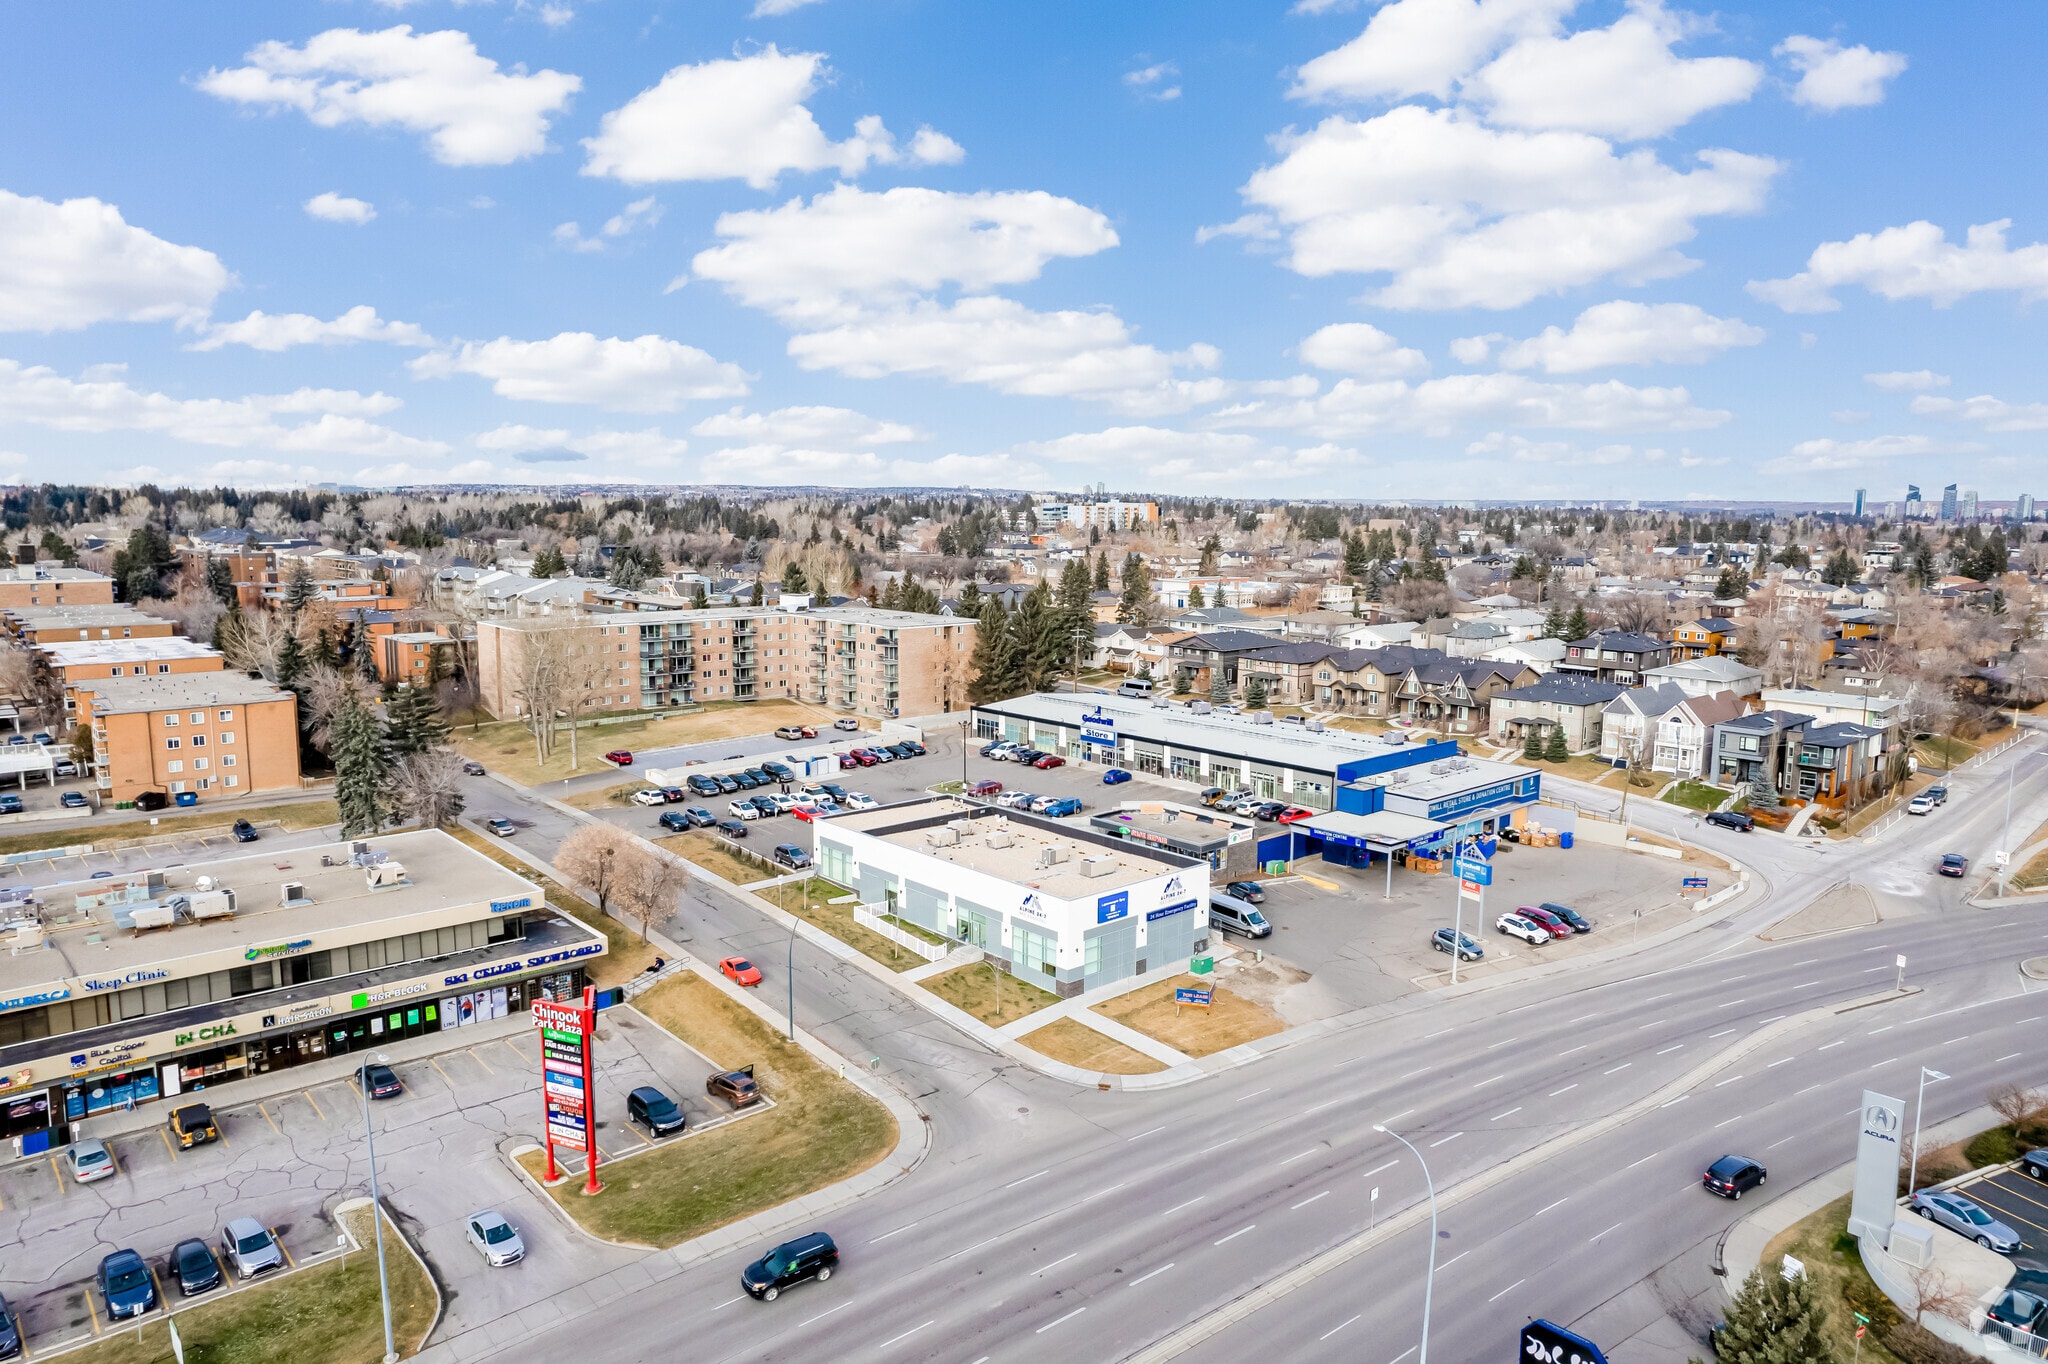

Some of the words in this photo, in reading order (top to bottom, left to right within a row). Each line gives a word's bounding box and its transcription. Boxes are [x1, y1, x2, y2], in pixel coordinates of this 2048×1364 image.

[1082, 714, 1114, 726] Goodwill
[1086, 729, 1109, 739] Store
[1443, 799, 1458, 810] RETAIL
[1458, 794, 1472, 805] STORE
[1475, 787, 1496, 800] DONATION
[1495, 783, 1512, 794] CENTRE
[1313, 828, 1332, 836] DONATION
[1332, 833, 1348, 841] CENTRE
[1456, 859, 1481, 871] Godwill
[1160, 892, 1175, 901] ALPINE
[490, 898, 531, 912] RENOIR
[1019, 906, 1035, 915] ALPINE
[1164, 906, 1184, 915] Emergency
[267, 948, 303, 958] Services
[444, 973, 468, 986] SKI
[473, 961, 523, 979] CELLAR
[527, 944, 603, 968] SNOWBOARD
[85, 977, 122, 991] Sleep
[125, 968, 169, 983] Clinic
[370, 992, 392, 1002] H&R
[394, 983, 427, 997] BLOCK
[278, 1013, 301, 1025] HAIR
[302, 1006, 333, 1020] SALON
[532, 1003, 581, 1025] Chinook
[532, 1016, 555, 1030] Park
[556, 1021, 583, 1035] Plaza
[175, 1031, 194, 1046] IN
[90, 1049, 110, 1058] Blue
[114, 1041, 147, 1053] Copper
[557, 1043, 575, 1052] SALON
[99, 1053, 132, 1066] Capital
[563, 1055, 582, 1064] BLOCK
[560, 1104, 584, 1116] LIQUOR
[1864, 1129, 1896, 1143] ACURA
